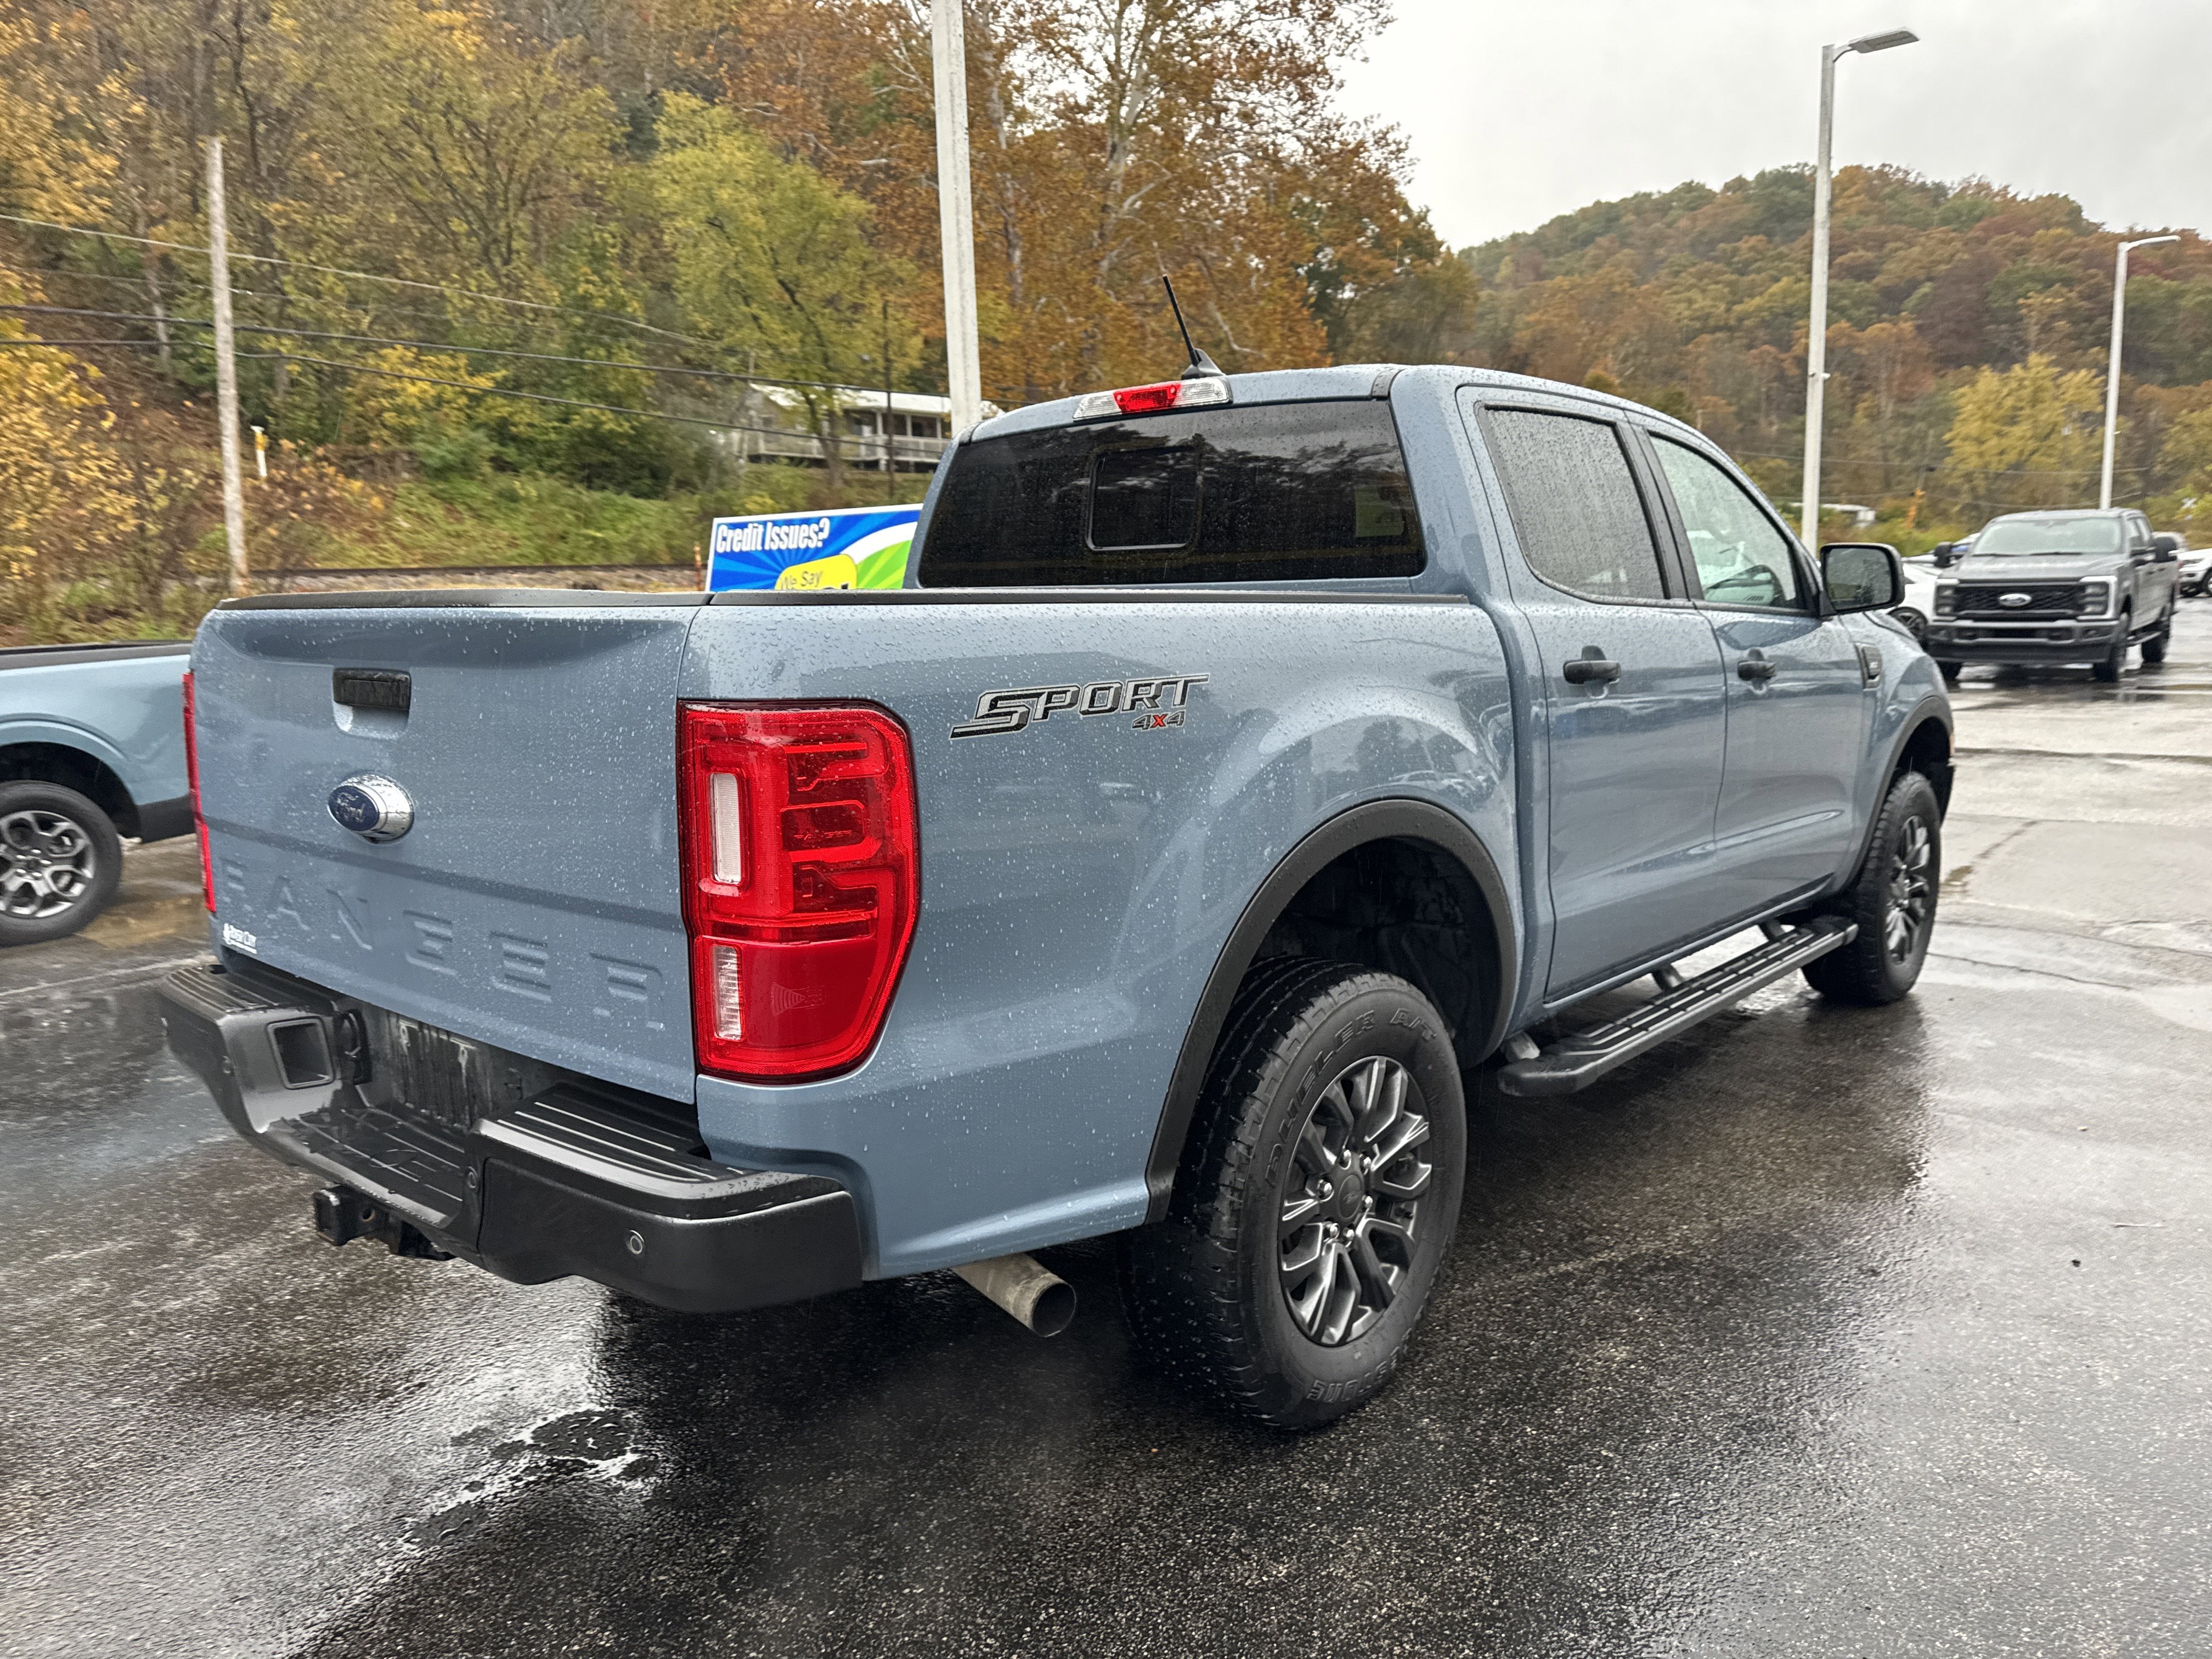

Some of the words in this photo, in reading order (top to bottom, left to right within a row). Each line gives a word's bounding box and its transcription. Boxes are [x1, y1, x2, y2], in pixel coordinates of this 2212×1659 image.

[716, 522, 764, 553] Credit
[764, 517, 831, 550] Issues?
[800, 570, 823, 588] Say
[948, 673, 1211, 741] SPORT
